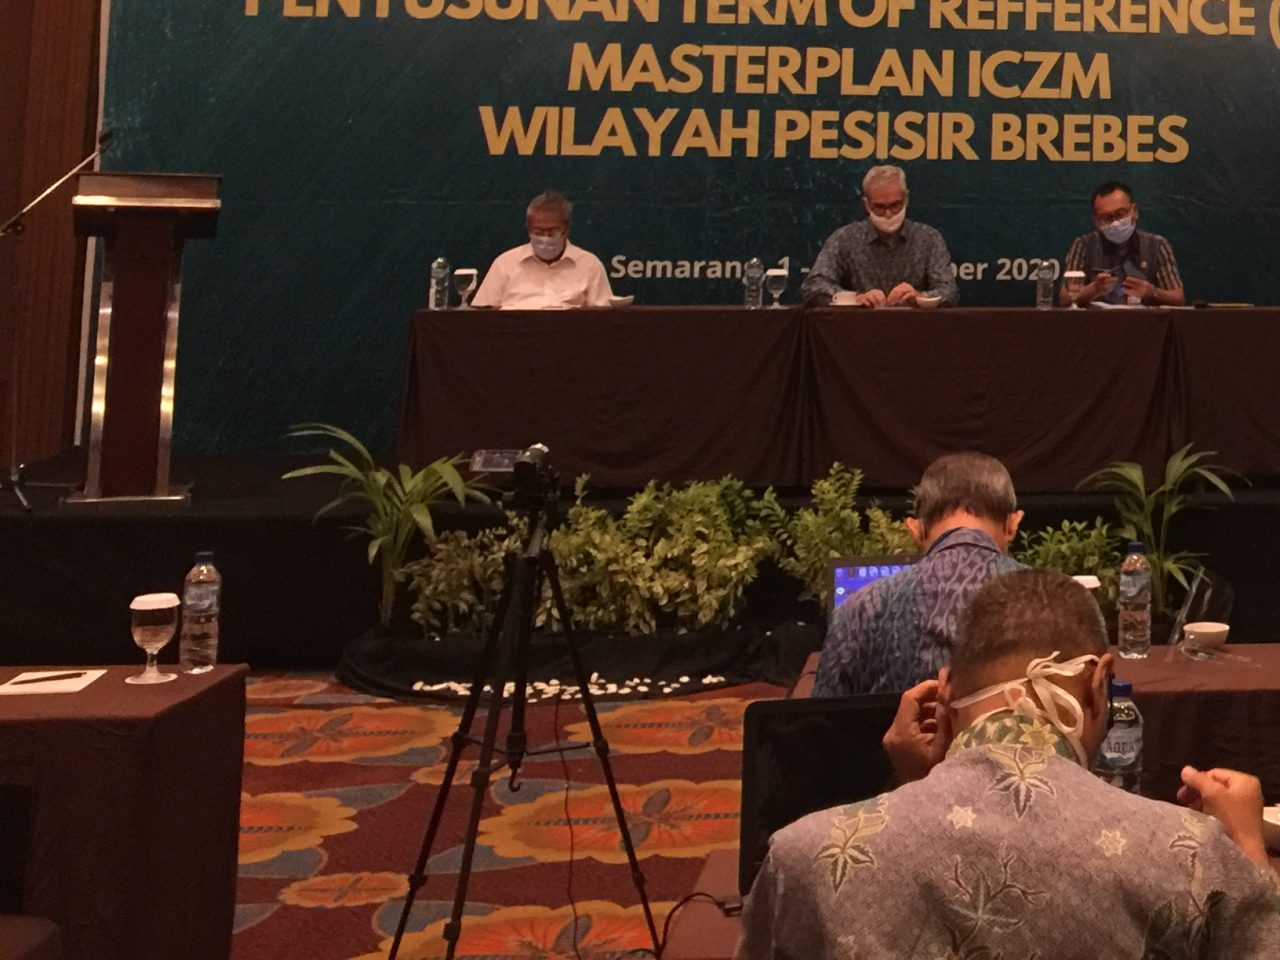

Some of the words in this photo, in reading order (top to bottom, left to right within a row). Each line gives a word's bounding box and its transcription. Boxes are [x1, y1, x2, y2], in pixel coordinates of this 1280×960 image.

[567, 42, 954, 97] MASTERPLAN
[967, 50, 1112, 100] ICZM
[478, 105, 759, 158] WILAYAH
[774, 109, 980, 161] PESISIR
[991, 113, 1190, 164] BREBES
[610, 254, 758, 280] Semaran
